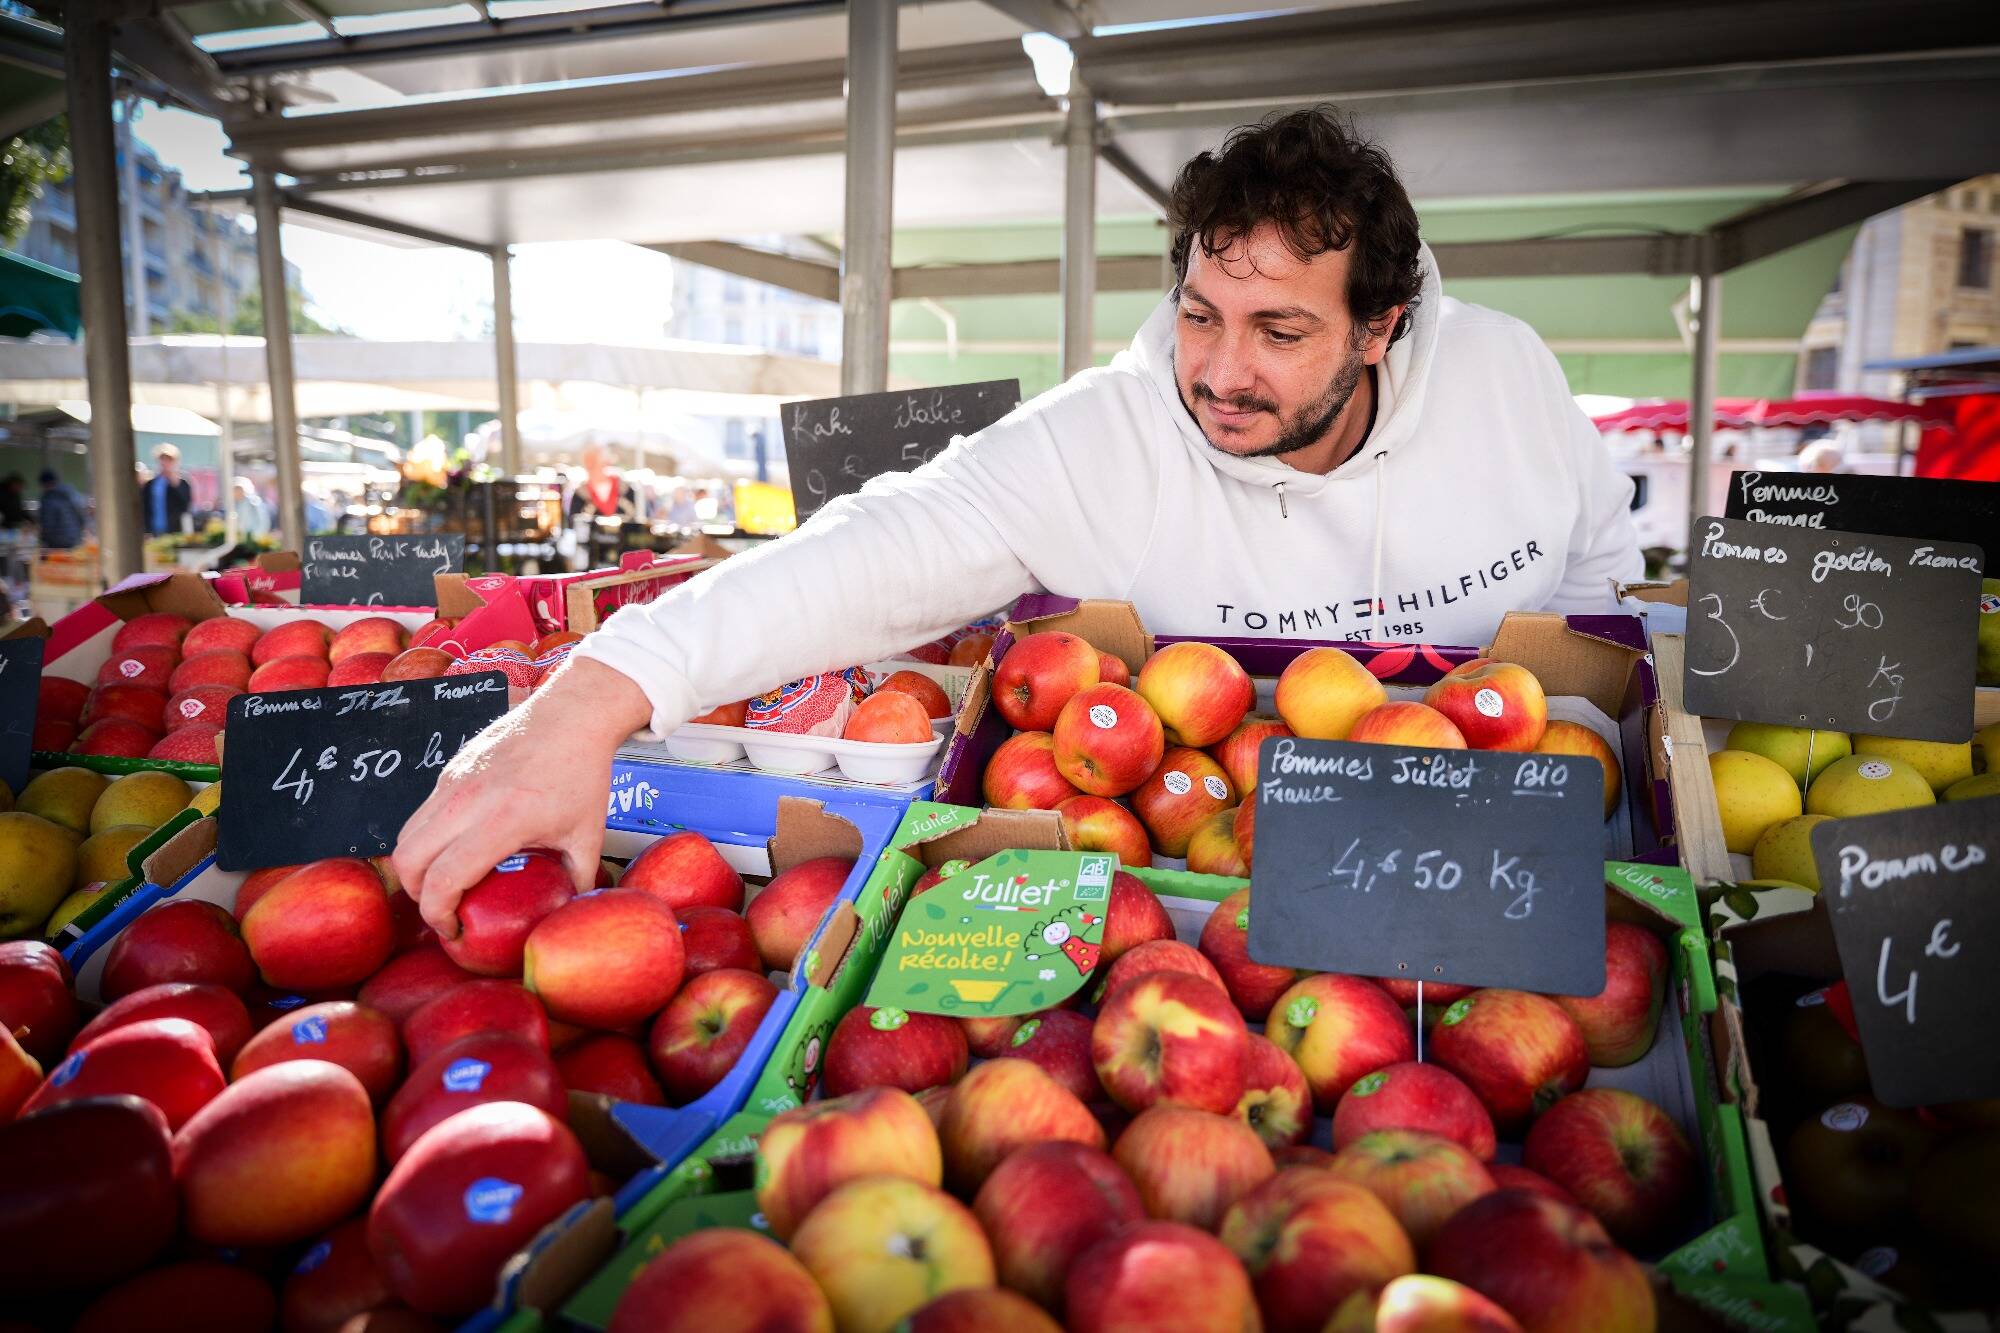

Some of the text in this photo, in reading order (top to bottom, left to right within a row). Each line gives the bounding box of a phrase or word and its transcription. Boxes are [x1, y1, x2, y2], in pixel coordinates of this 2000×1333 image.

[1740, 471, 1840, 506] Pommes
[1701, 522, 1788, 564] Pommes
[1909, 546, 1982, 574] France
[1216, 539, 1545, 634] TOMMY HILFIGER
[1345, 622, 1424, 642] EST 1985
[244, 676, 507, 718] Pommes JAZZ France
[349, 748, 402, 783] 50
[1270, 738, 1375, 782] Pommes
[1390, 754, 1481, 789] Juliet
[1261, 776, 1343, 806] France
[1413, 849, 1462, 891] 50
[1838, 844, 1987, 899] Pommes
[900, 923, 1022, 949] Nouvelle
